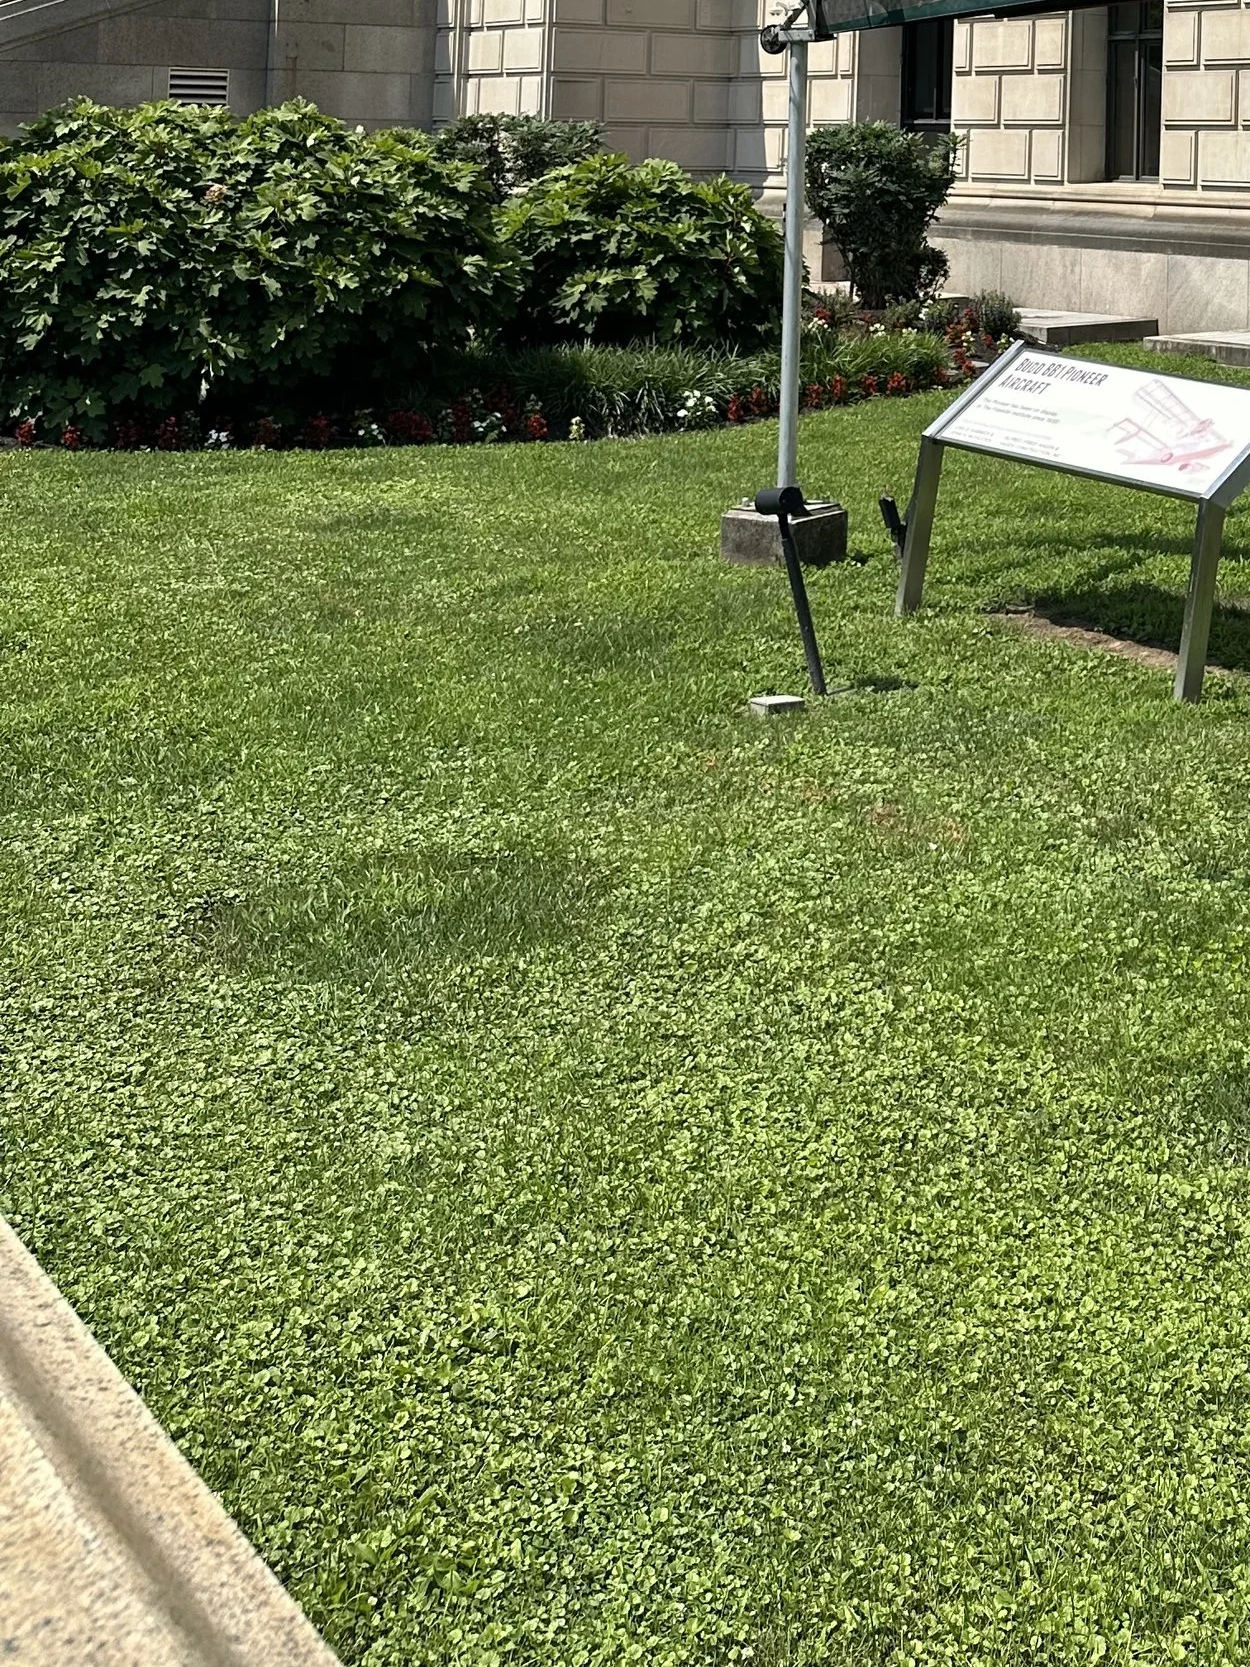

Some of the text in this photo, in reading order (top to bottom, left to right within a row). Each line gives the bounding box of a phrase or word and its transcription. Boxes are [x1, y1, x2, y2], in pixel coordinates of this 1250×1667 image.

[1014, 358, 1045, 374] BUDD
[1060, 366, 1109, 386] PIONEER
[997, 374, 1051, 395] AIRCRAFT
